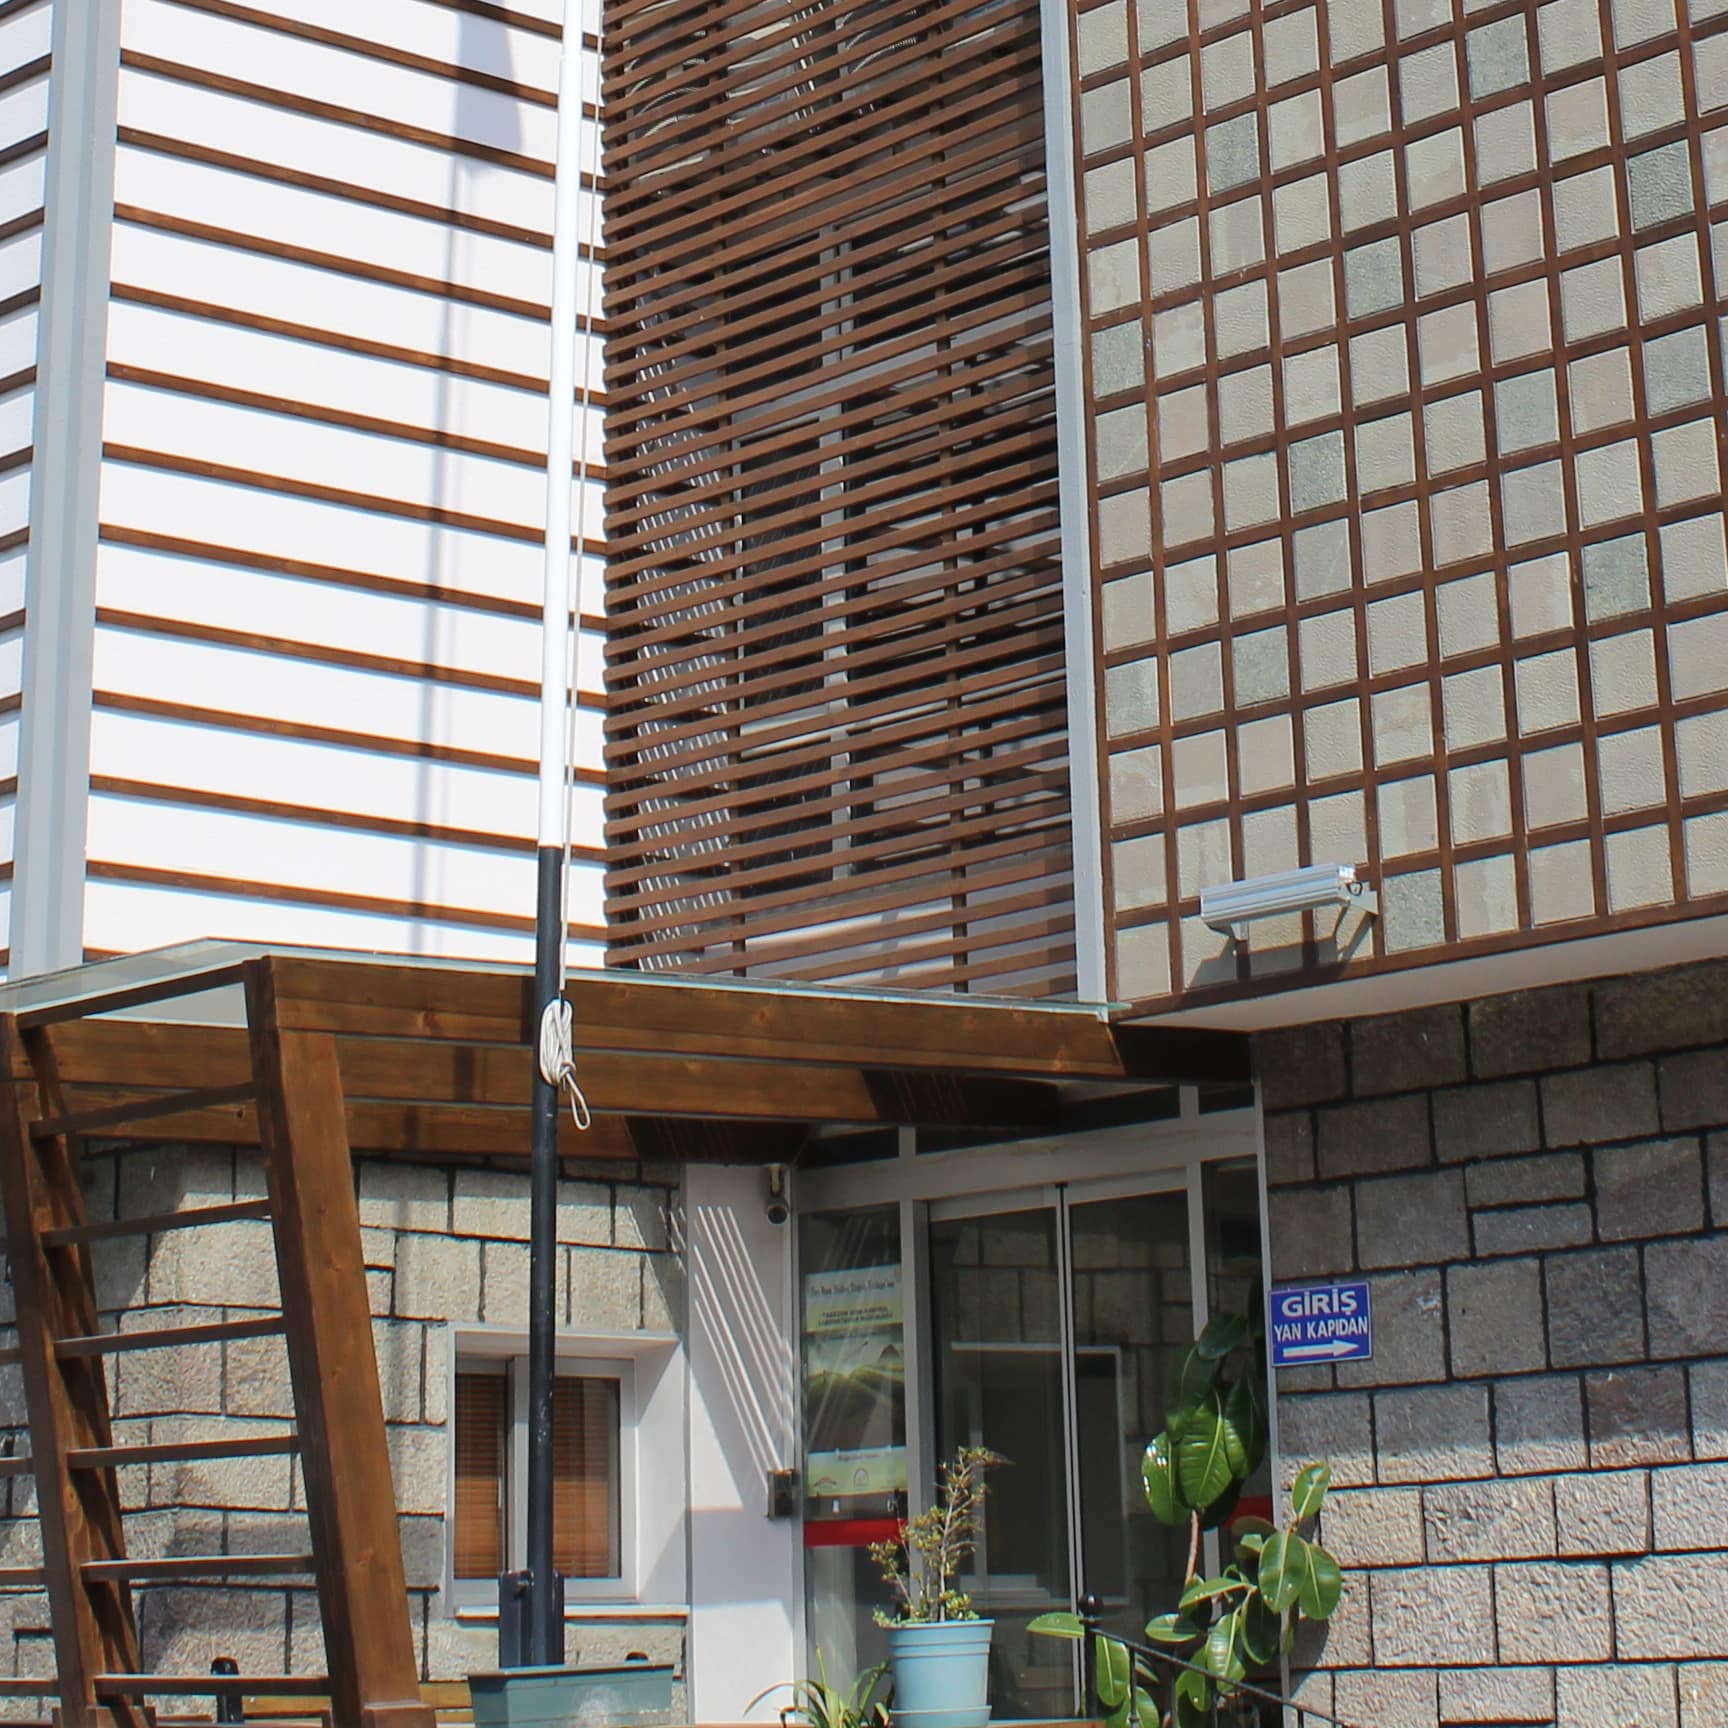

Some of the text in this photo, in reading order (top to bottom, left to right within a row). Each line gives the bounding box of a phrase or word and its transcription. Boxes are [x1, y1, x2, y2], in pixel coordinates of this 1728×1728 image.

[1281, 1288, 1358, 1317] GİRİŞ
[1274, 1315, 1368, 1343] YAN KAPIDAN
